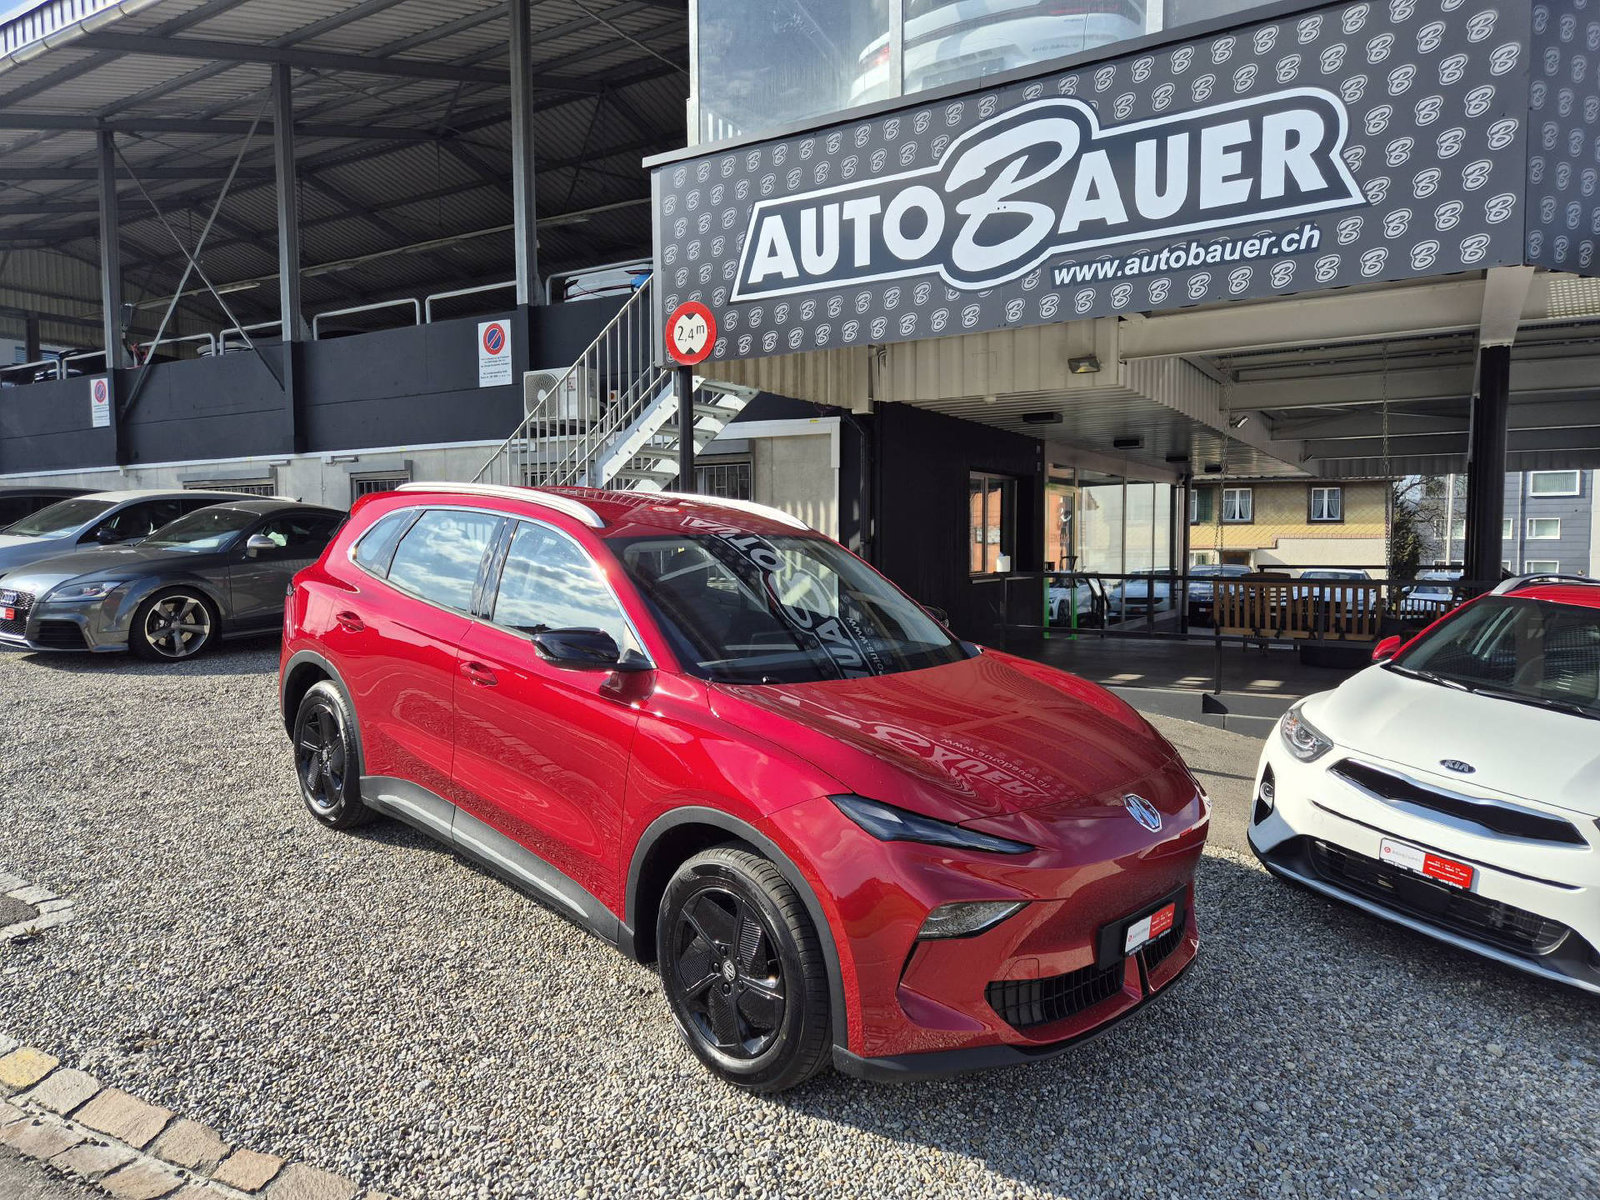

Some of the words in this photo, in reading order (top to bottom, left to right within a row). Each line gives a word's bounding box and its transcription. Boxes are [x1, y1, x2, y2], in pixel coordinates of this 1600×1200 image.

[748, 185, 945, 284] AUTO
[945, 110, 1329, 272] BAUER
[1054, 224, 1321, 286] www.autobauer.ch
[1443, 760, 1470, 772] KIA
